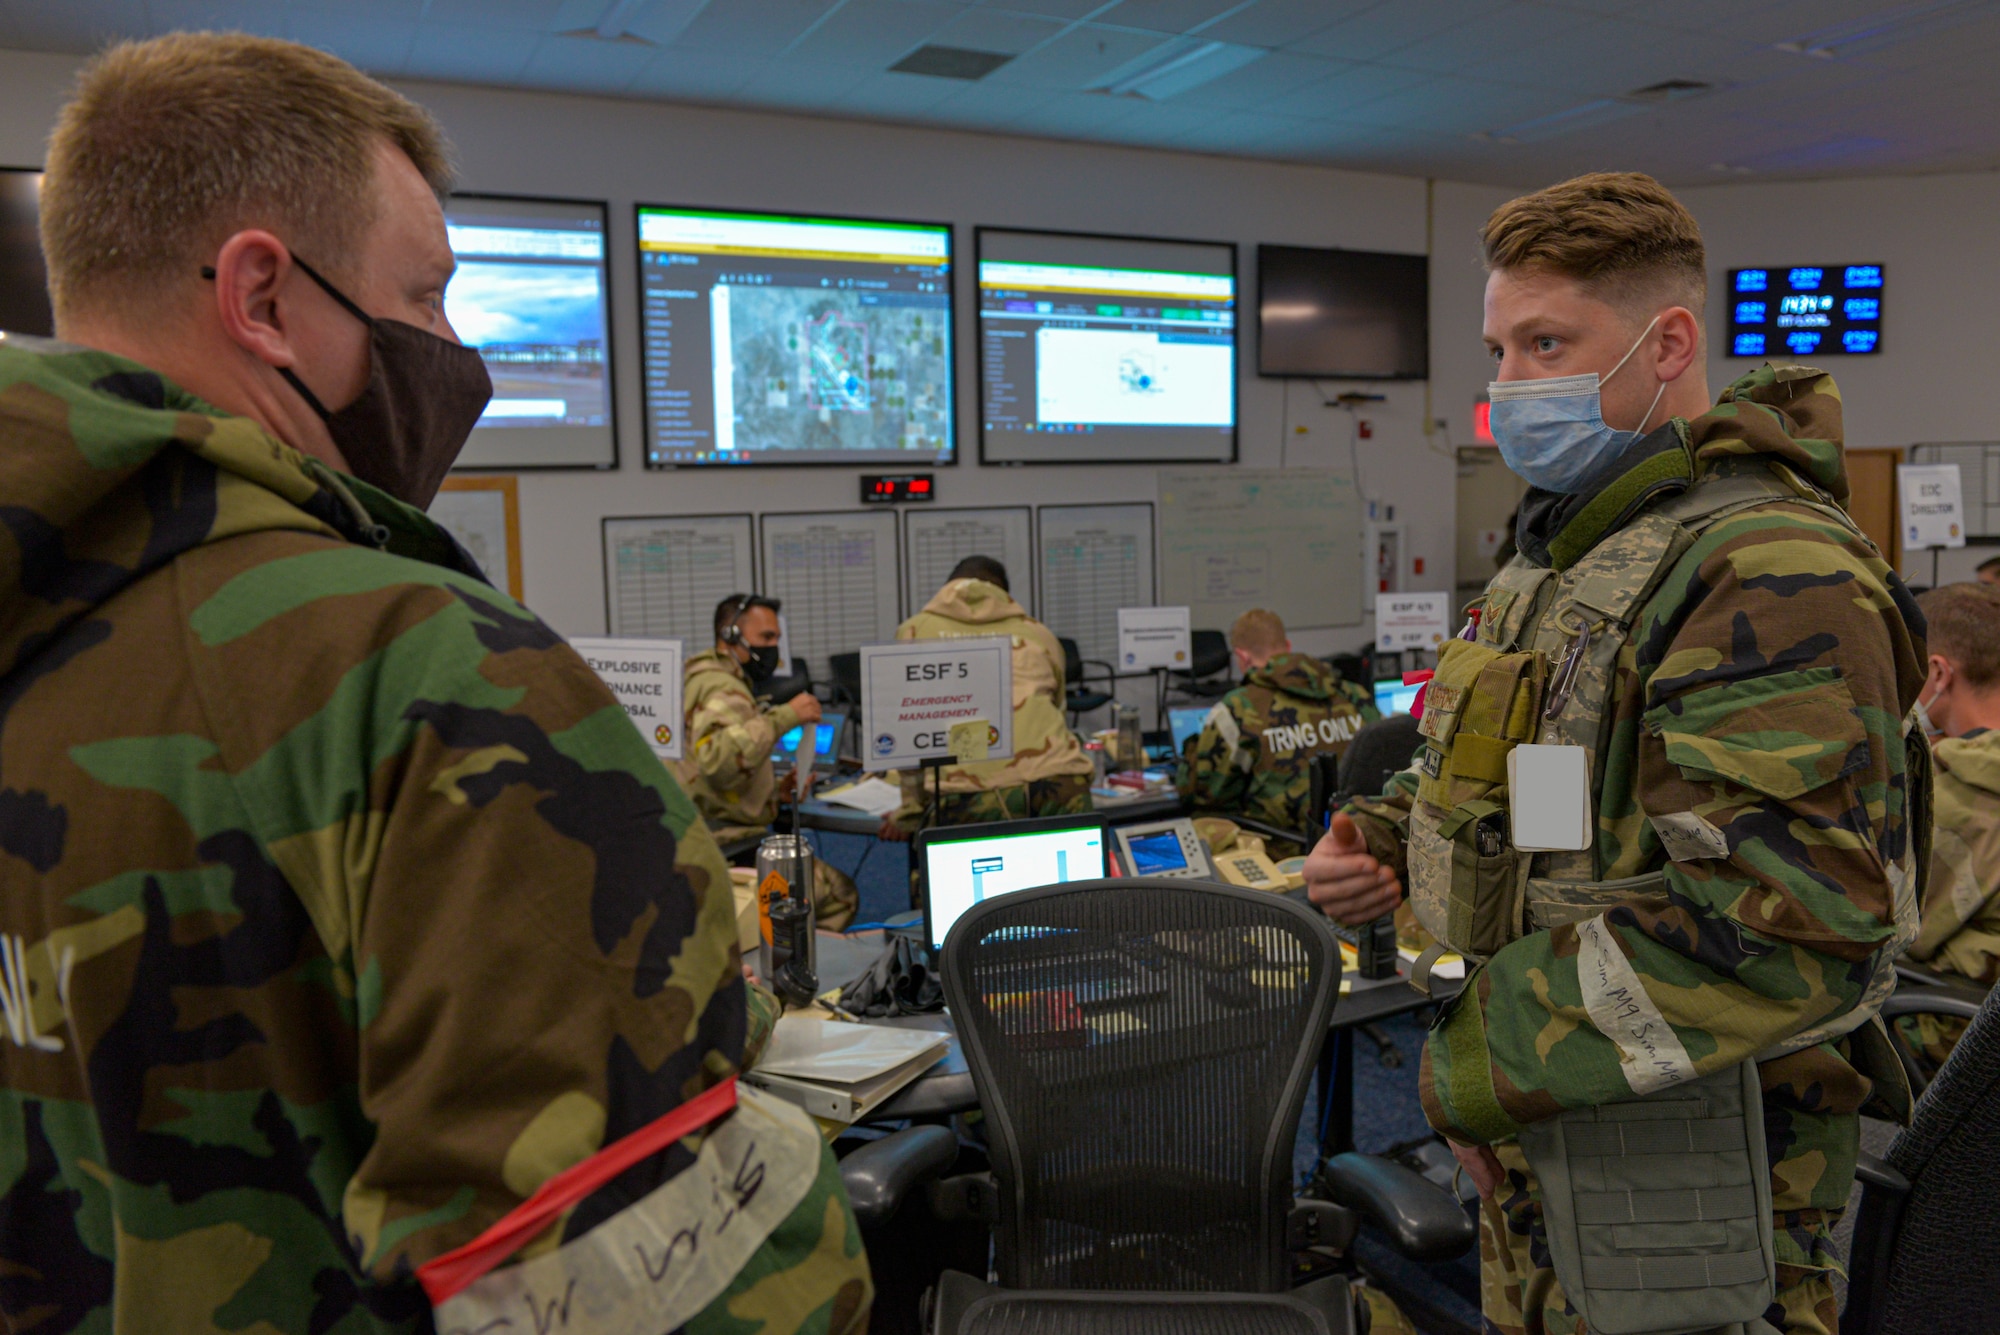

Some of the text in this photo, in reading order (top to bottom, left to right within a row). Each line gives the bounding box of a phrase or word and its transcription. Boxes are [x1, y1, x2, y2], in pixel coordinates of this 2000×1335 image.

[588, 658, 661, 674] EXPLOSIVE
[905, 662, 968, 682] ESF 5
[606, 682, 662, 696] DNANCE
[900, 694, 973, 707] EMERGENCY
[623, 704, 656, 717] OSAL
[898, 708, 979, 722] MANAGEMENT
[914, 732, 951, 749] CE
[1262, 714, 1363, 753] TRNG ONLY
